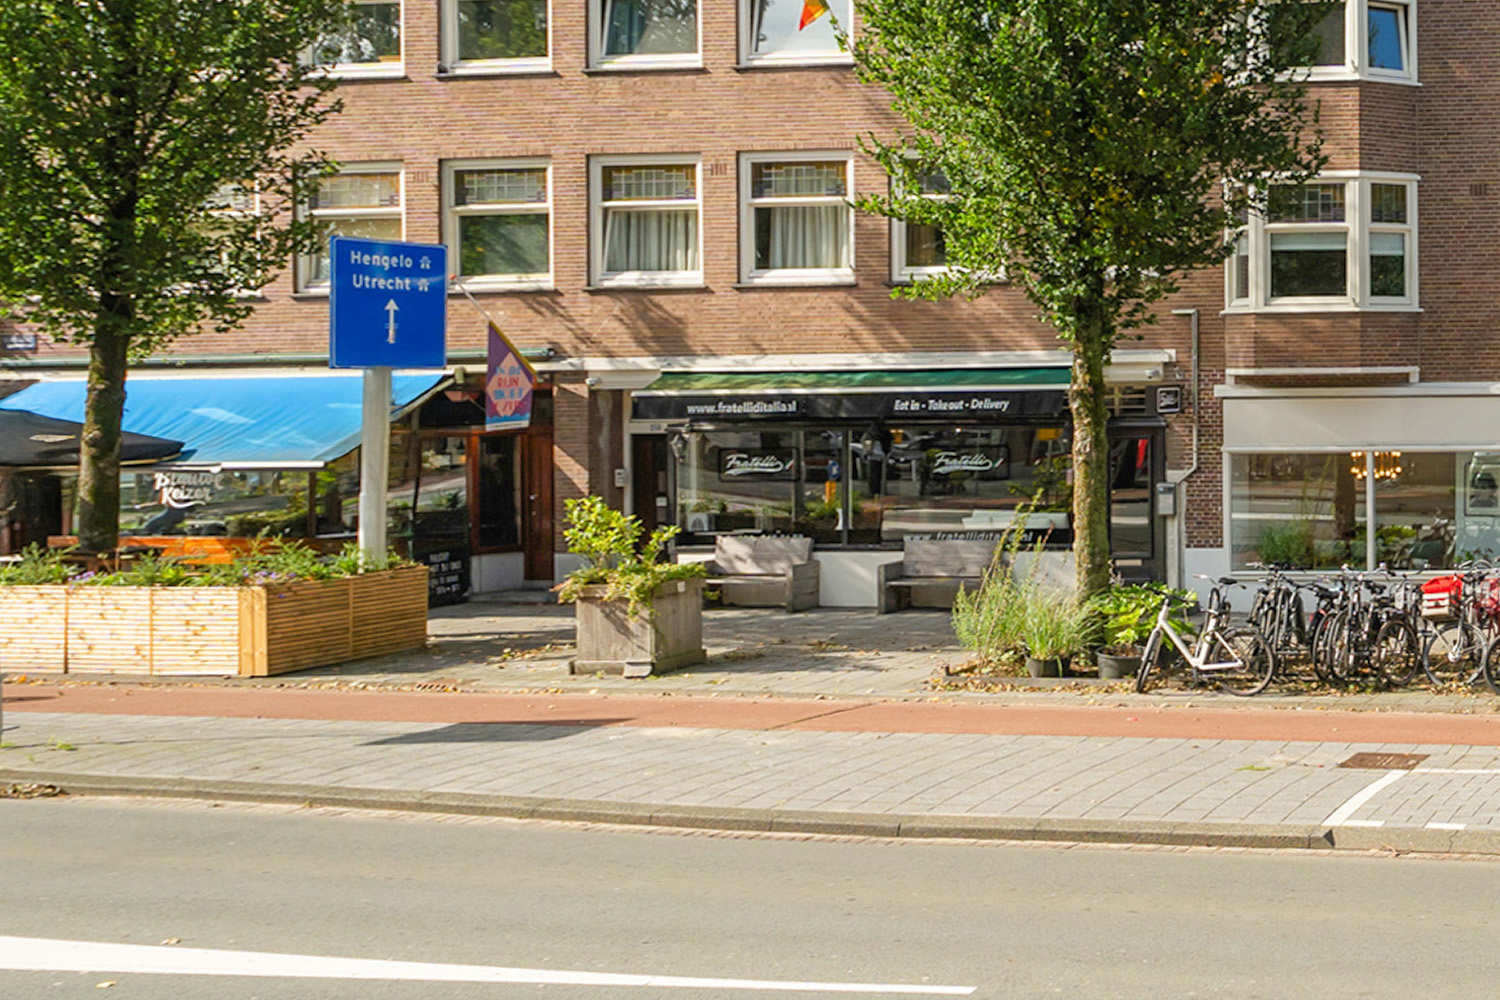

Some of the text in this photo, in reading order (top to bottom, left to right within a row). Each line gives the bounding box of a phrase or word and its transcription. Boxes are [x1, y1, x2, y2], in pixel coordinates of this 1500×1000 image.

[350, 250, 413, 271] Hengelo
[352, 273, 411, 291] Utrecht
[894, 400, 909, 411] Eat
[910, 400, 919, 411] in
[928, 399, 964, 411] Takeout
[970, 398, 1010, 412] Delivery
[725, 453, 784, 476] Fratelli
[933, 452, 993, 474] Fratelli
